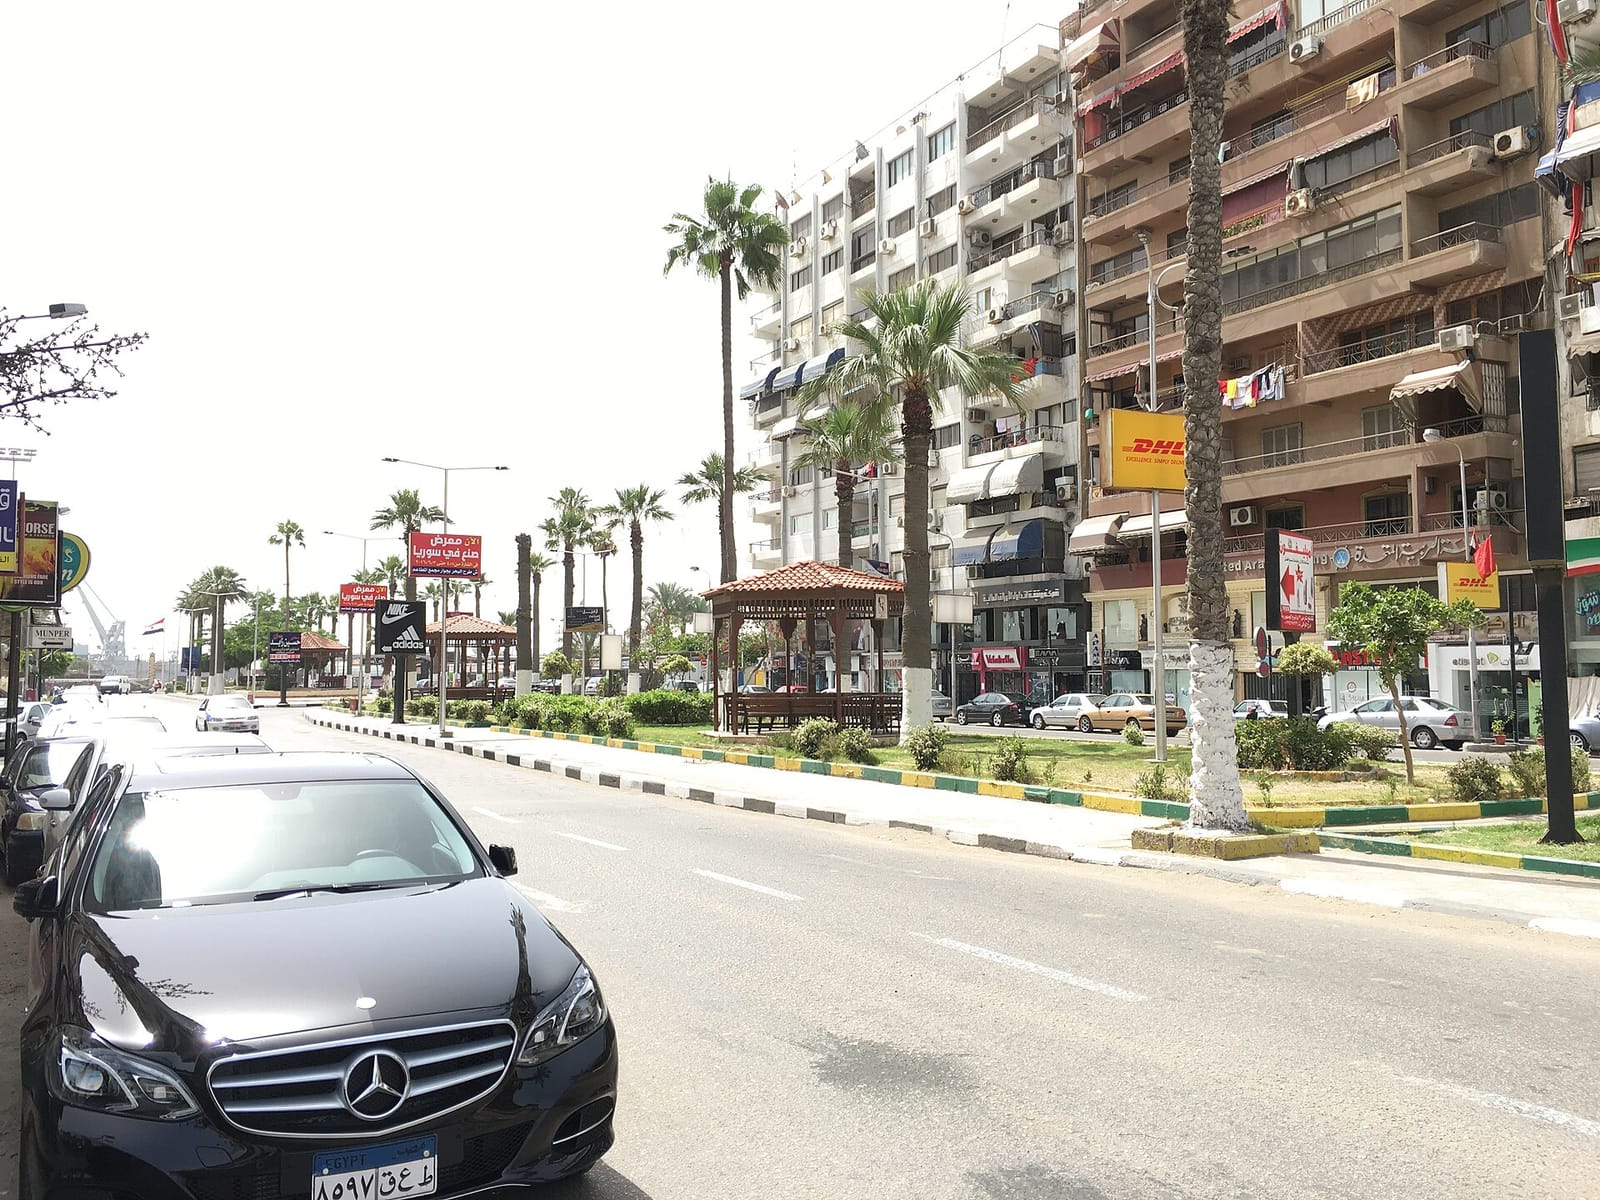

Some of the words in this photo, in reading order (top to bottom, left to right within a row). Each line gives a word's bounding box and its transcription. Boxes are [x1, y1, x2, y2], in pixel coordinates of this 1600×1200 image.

[1133, 438, 1184, 456] DHL
[430, 534, 463, 547] معرض
[413, 545, 442, 559] سوريا
[442, 548, 461, 560] في
[461, 548, 479, 561] صنع
[1354, 543, 1399, 564] المتحدة
[1244, 560, 1265, 571] Ara
[1459, 577, 1488, 587] DHL
[386, 603, 410, 615] NIKE
[35, 629, 70, 638] MUNPER
[392, 640, 424, 649] adidas
[325, 1153, 368, 1171] EGYPT
